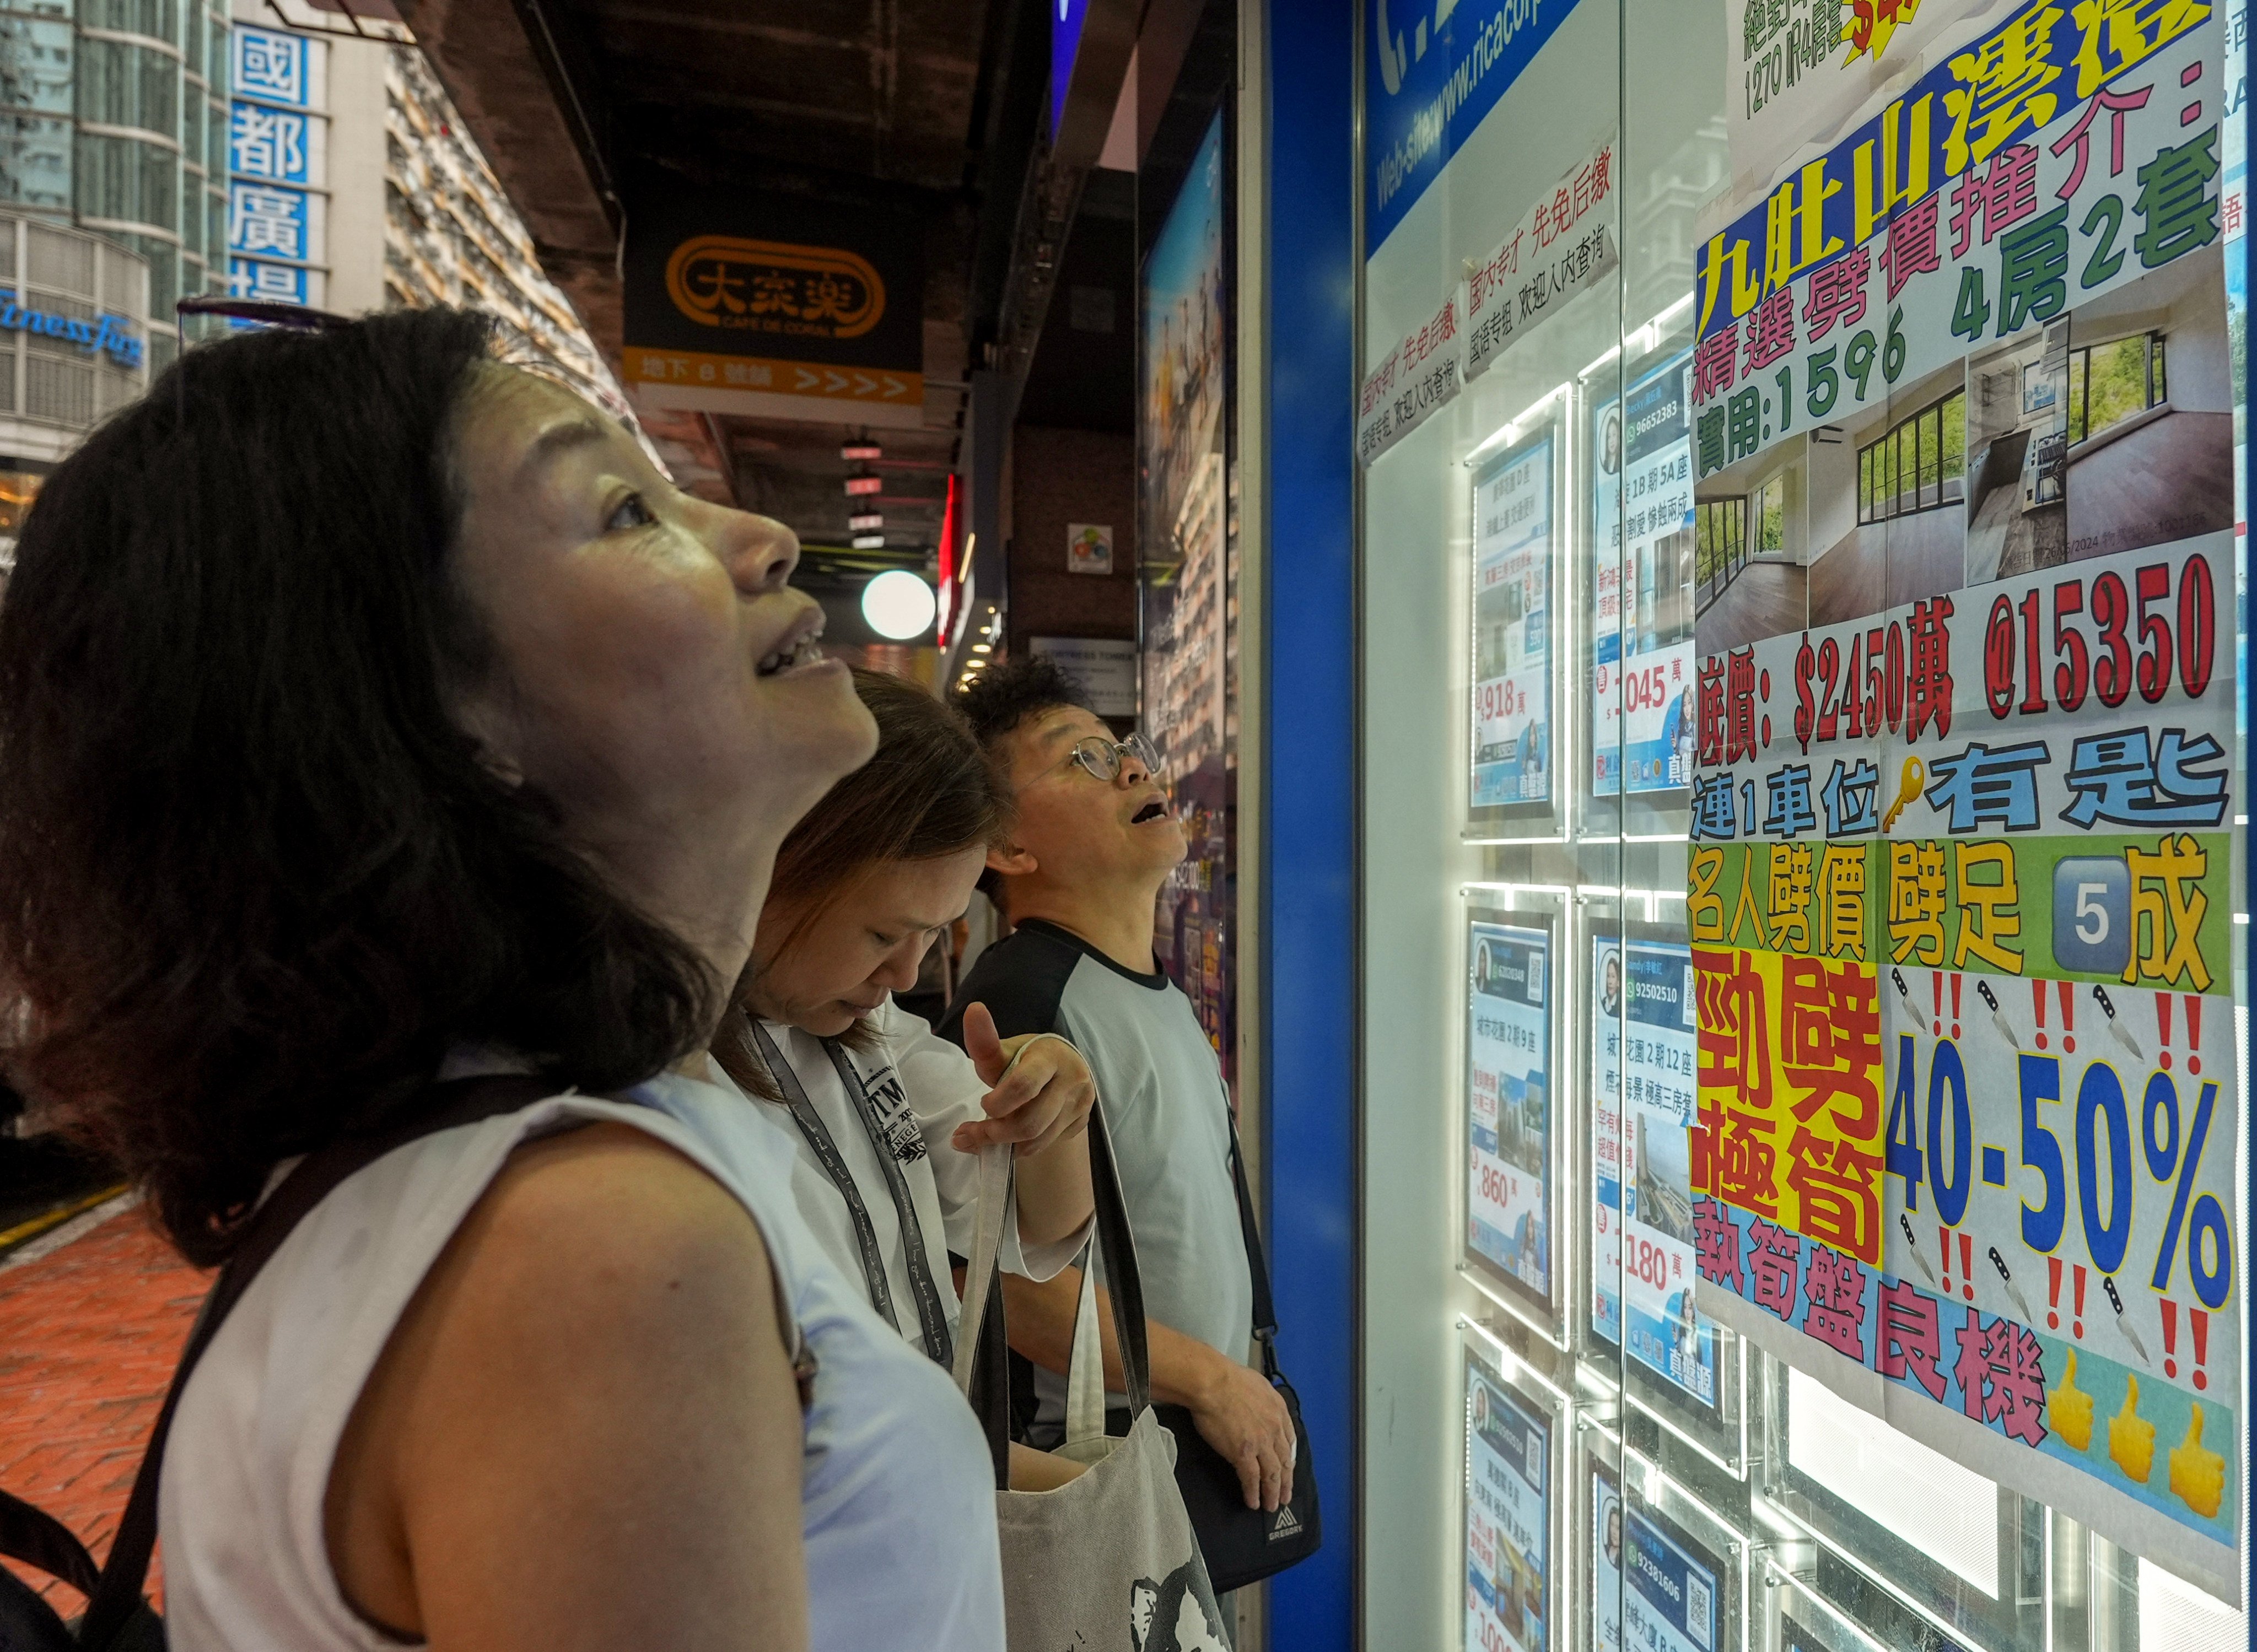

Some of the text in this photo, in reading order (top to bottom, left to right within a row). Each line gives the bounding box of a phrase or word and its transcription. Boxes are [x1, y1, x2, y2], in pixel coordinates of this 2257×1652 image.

[1745, 44, 1782, 120] 1270
[1951, 123, 2221, 343] 4房2套
[1636, 399, 1677, 436] 96652383
[1660, 461, 1674, 486] 5A
[1795, 593, 1955, 755] $2450萬
[1984, 553, 2216, 720] @15350
[1485, 679, 1514, 721] 918
[1690, 725, 2230, 842] 連1車位 有匙
[1687, 841, 1866, 963] 名人劈價
[1889, 838, 2024, 977] 劈足
[1635, 981, 1677, 1003] 92502510
[1647, 1043, 1653, 1063] 2
[1666, 1048, 1679, 1071] 12
[1681, 1049, 1692, 1078] 座
[1482, 1163, 1507, 1208] 860
[1884, 1032, 2233, 1314] 40-50%
[1269, 1524, 1303, 1541] GREGORY
[1637, 1551, 1680, 1602] 92381606
